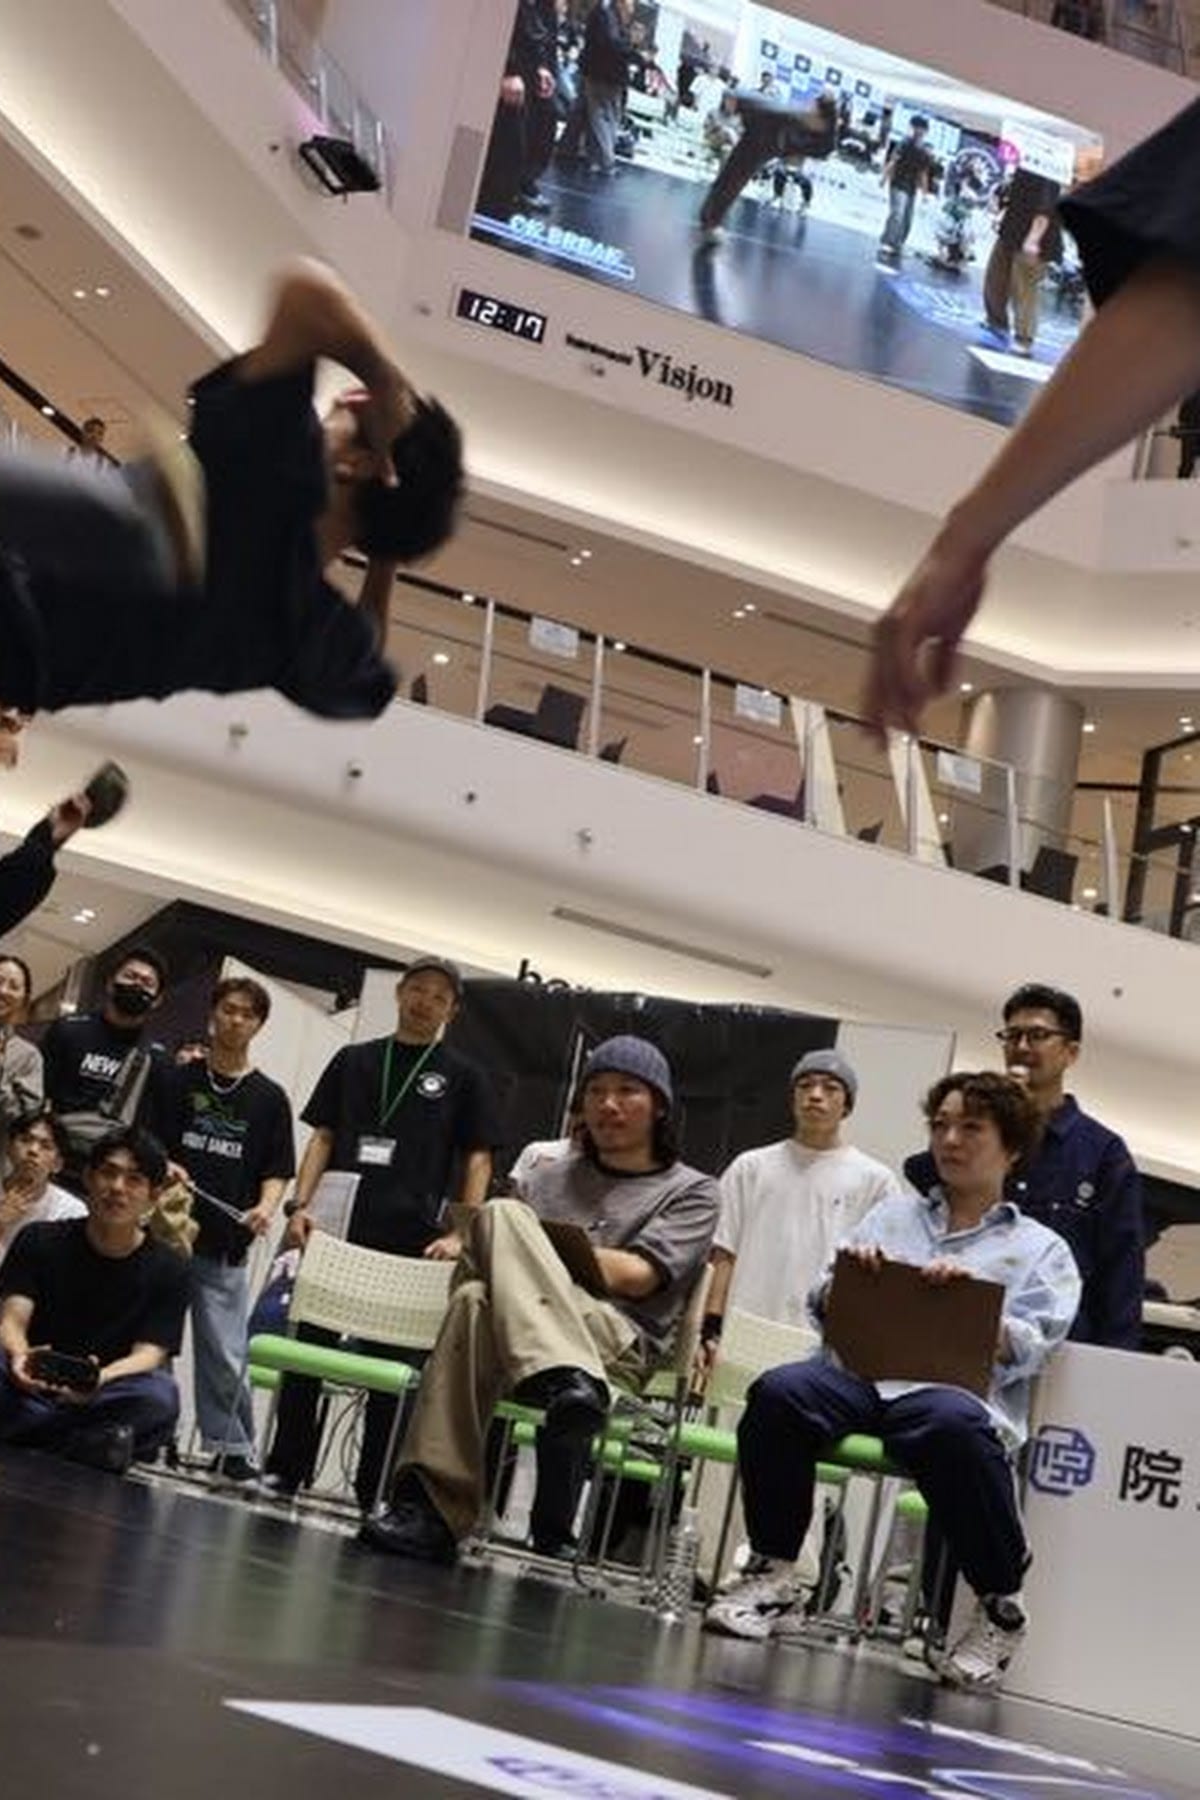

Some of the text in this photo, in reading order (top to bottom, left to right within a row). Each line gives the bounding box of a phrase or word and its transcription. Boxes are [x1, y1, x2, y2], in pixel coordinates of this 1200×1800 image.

[469, 298, 543, 339] 12:17
[635, 346, 735, 406] Vision
[81, 1052, 122, 1077] NEW
[1118, 1445, 1200, 1509] 院
